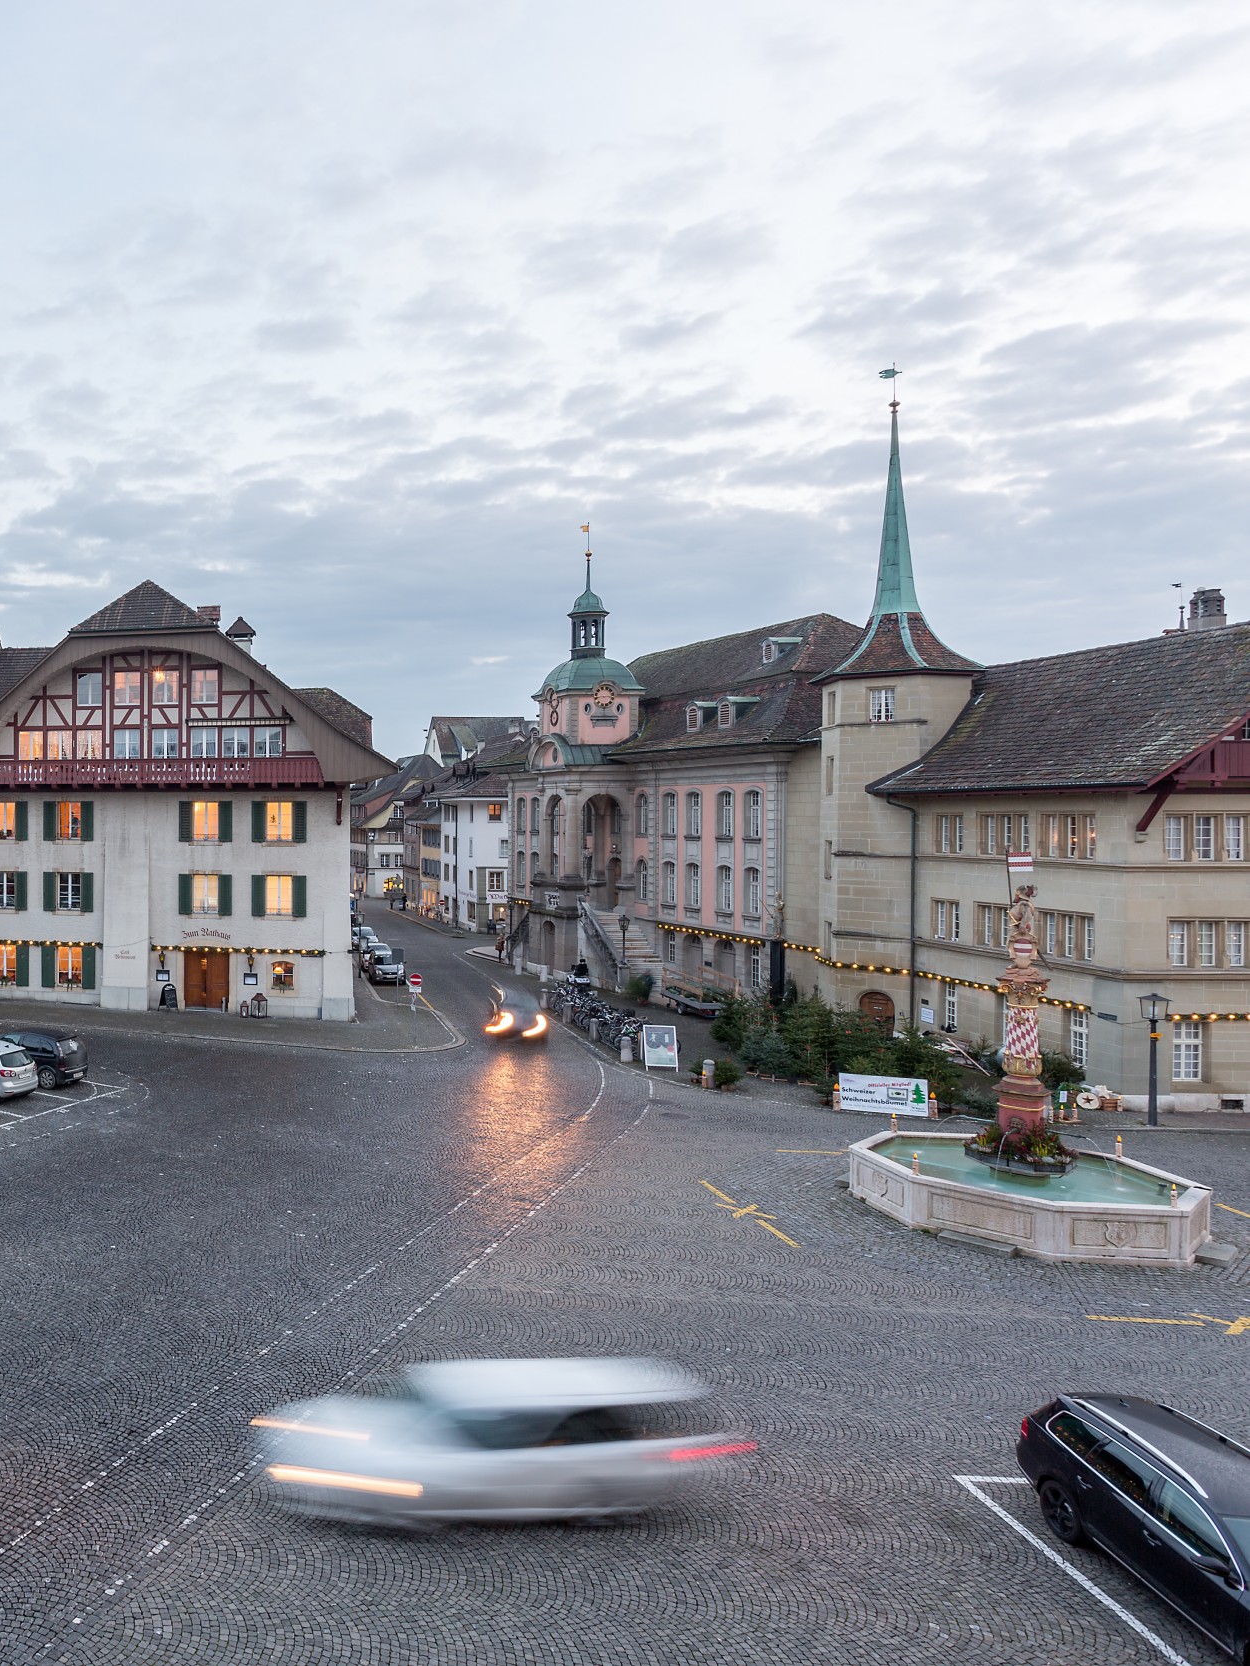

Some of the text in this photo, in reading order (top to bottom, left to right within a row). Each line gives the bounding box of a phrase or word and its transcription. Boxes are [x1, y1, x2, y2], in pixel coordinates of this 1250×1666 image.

[181, 928, 231, 940] Zum Rathaus
[841, 1086, 876, 1095] Schweizer
[841, 1096, 908, 1107] Weihnachtsbäume!
